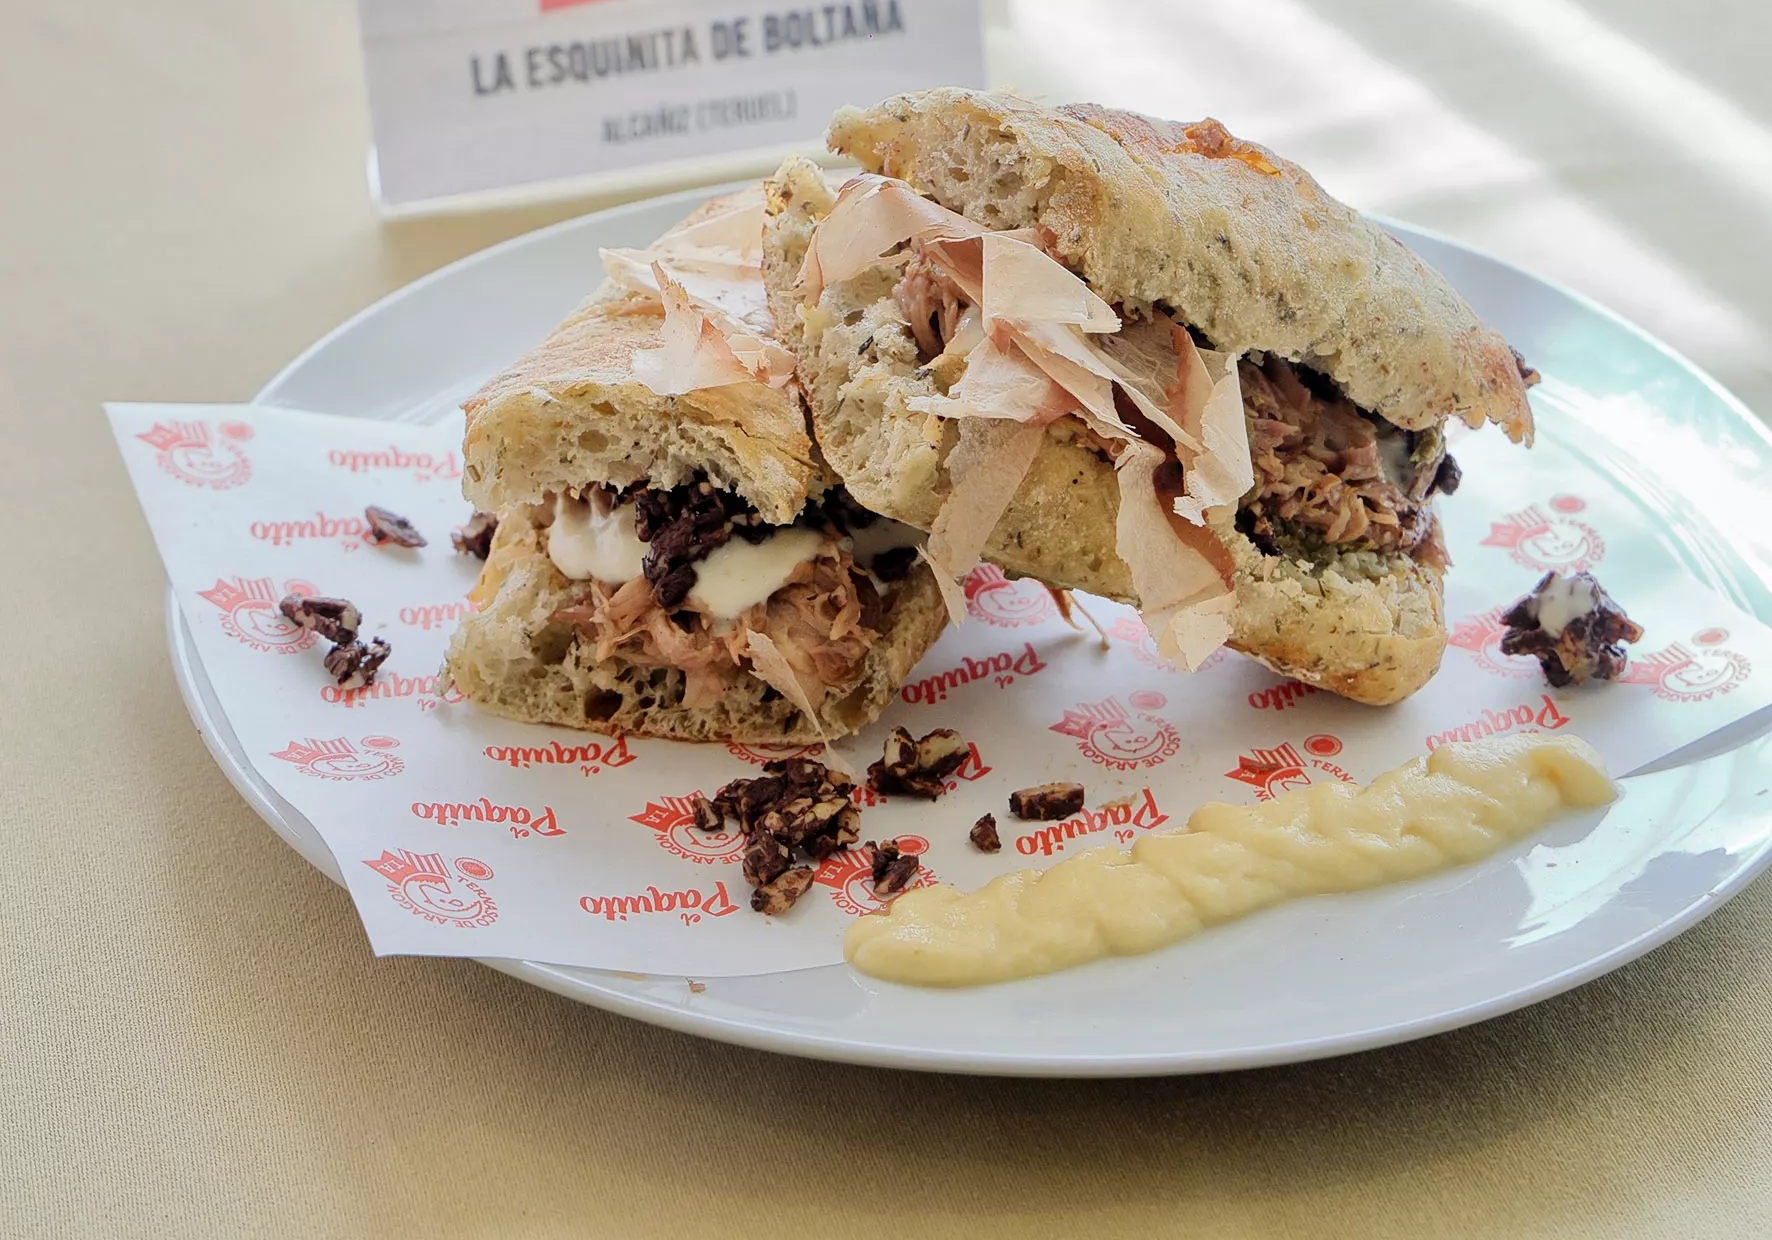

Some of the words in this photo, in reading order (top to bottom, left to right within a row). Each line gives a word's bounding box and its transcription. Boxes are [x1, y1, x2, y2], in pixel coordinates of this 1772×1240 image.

[470, 54, 516, 97] LA
[524, 27, 701, 89] ESQUINITA
[711, 17, 753, 62] DE
[328, 444, 462, 479] Paquito
[901, 642, 1048, 705] Paquito
[485, 736, 638, 769] Paquito
[1075, 741, 1138, 771] ARAGON
[1142, 754, 1165, 768] DE
[411, 796, 568, 838] Paquito
[509, 825, 531, 840] el
[1015, 788, 1170, 857] Paquito
[654, 833, 716, 865] ARAGON
[1114, 829, 1135, 845] el
[720, 853, 743, 865] DE
[385, 884, 448, 925] ARAGON
[456, 875, 499, 928] TERNASCO
[579, 881, 741, 922] Paquito
[451, 919, 478, 929] DE
[680, 912, 702, 928] el
